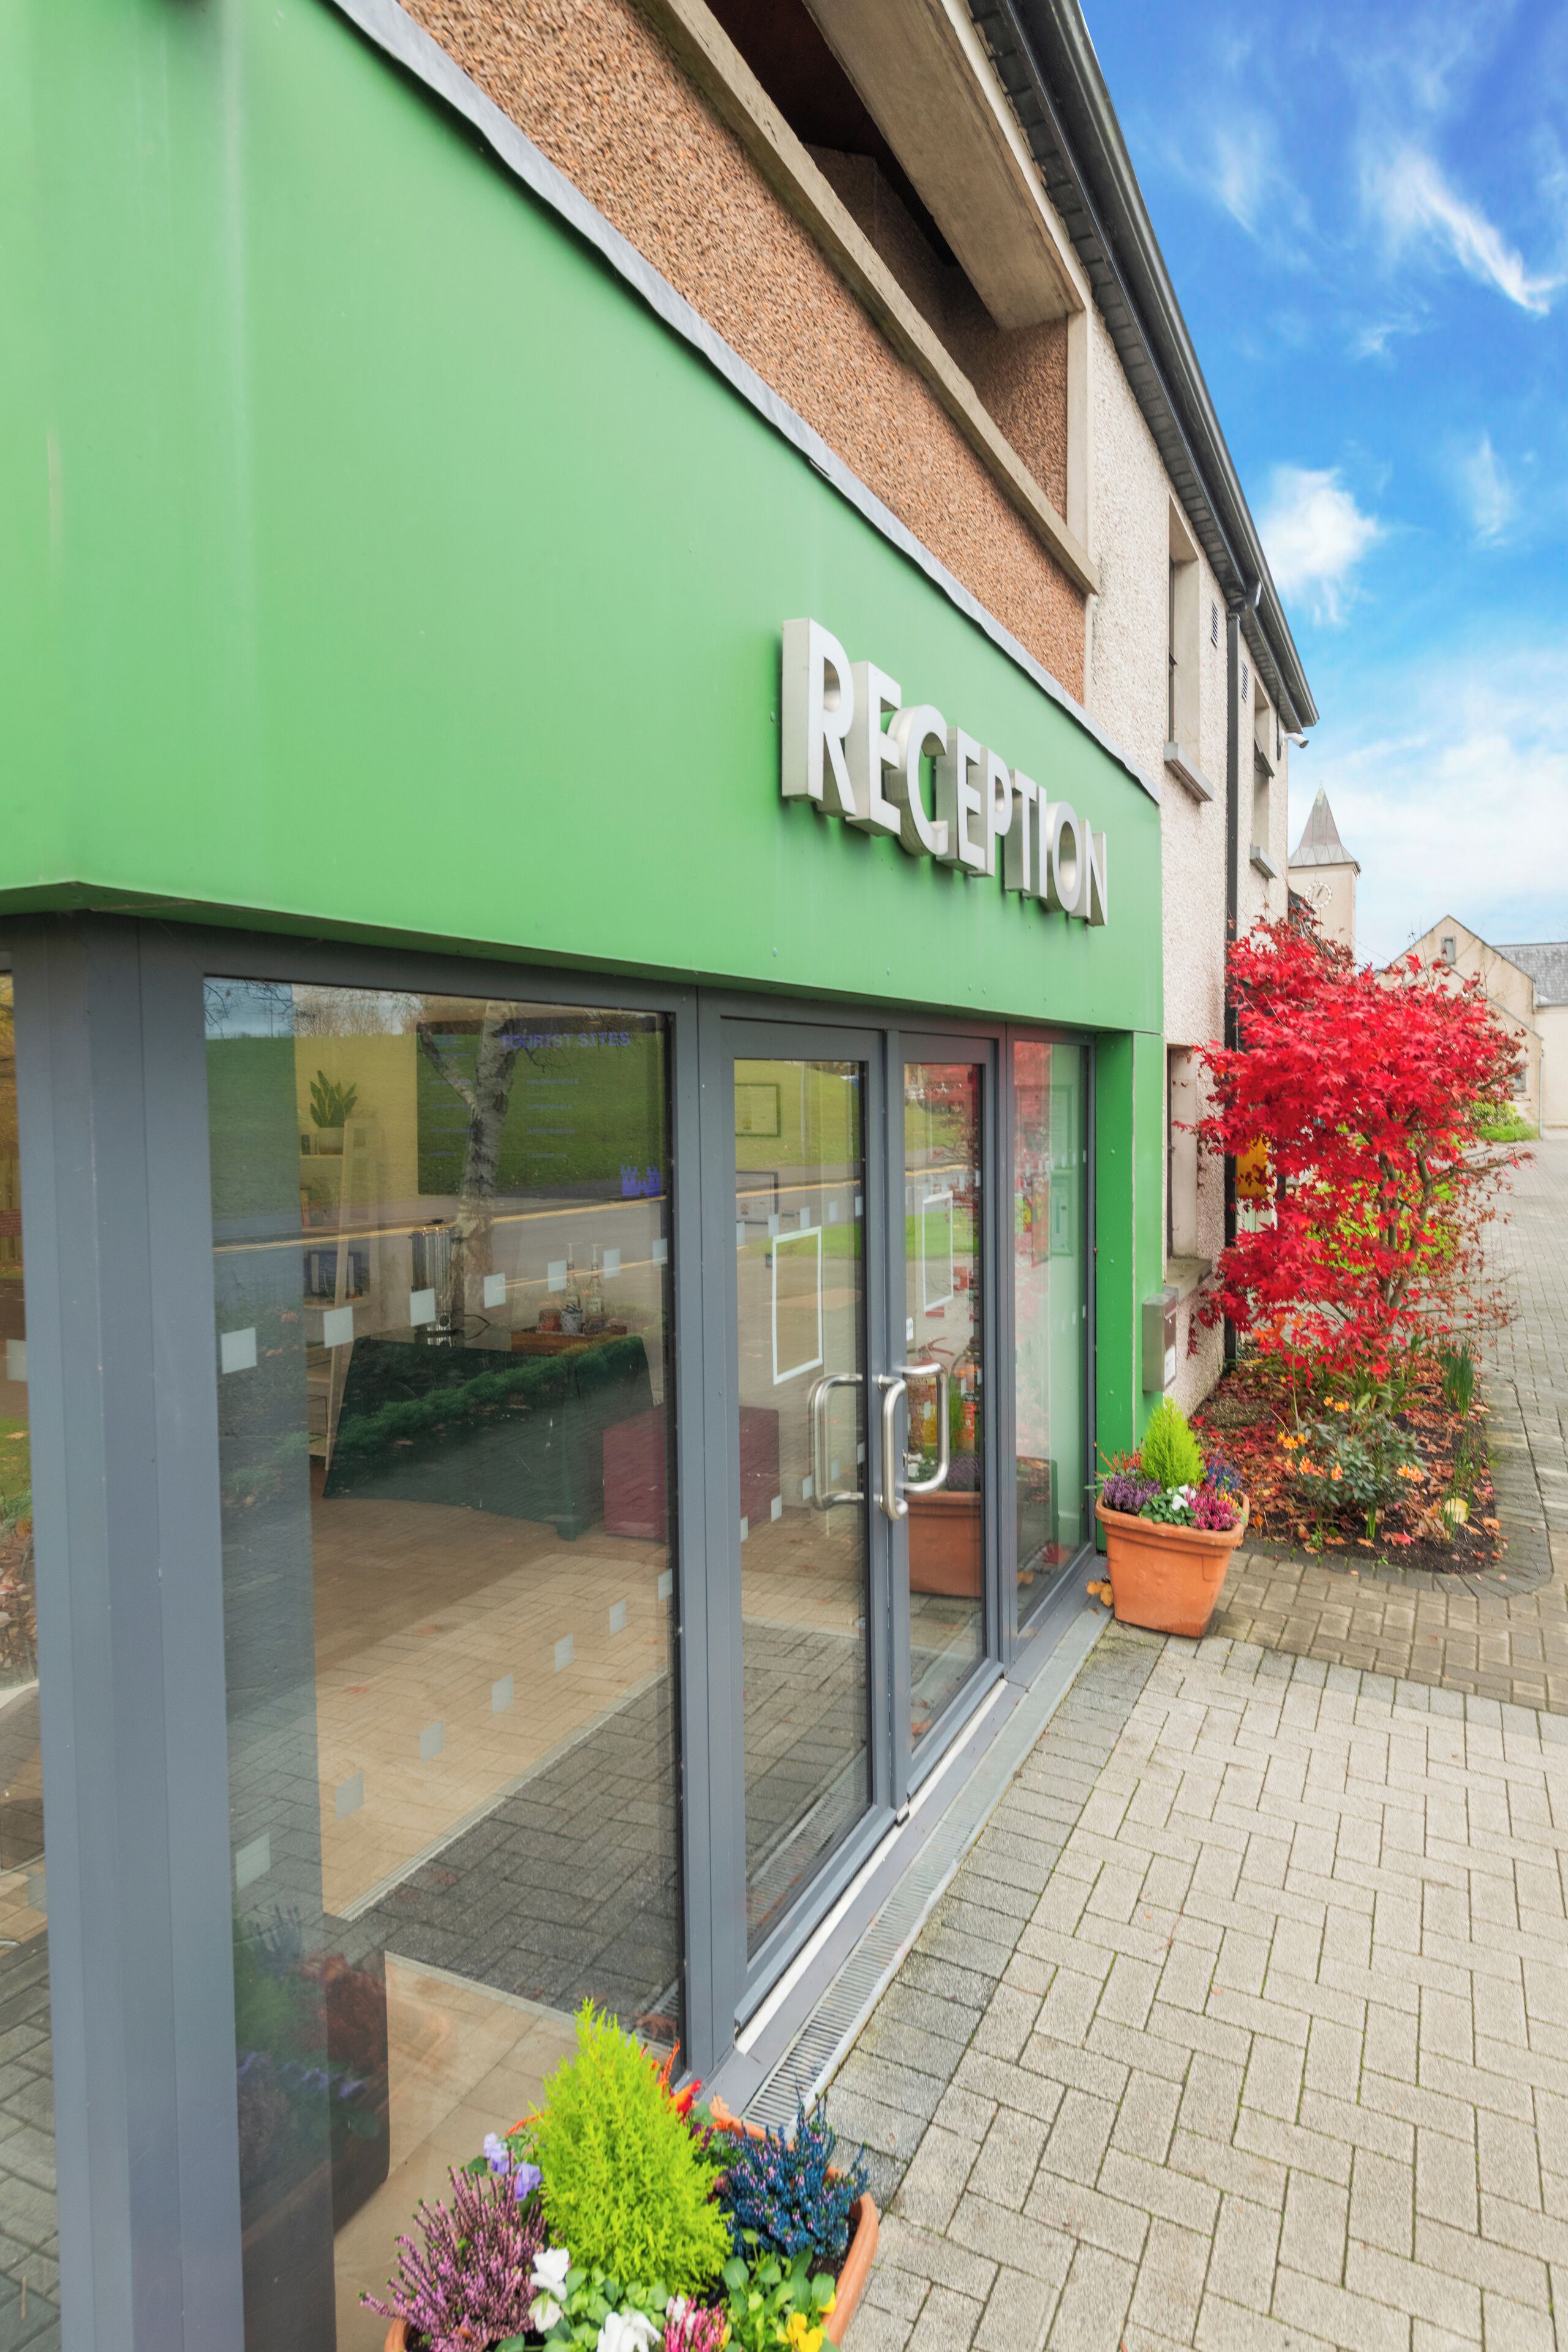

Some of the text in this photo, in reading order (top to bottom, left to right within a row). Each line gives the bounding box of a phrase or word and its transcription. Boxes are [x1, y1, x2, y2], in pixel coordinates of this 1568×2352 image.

[782, 617, 1107, 927] RECEPTION
[500, 1031, 631, 1049] TOURIST SITES
